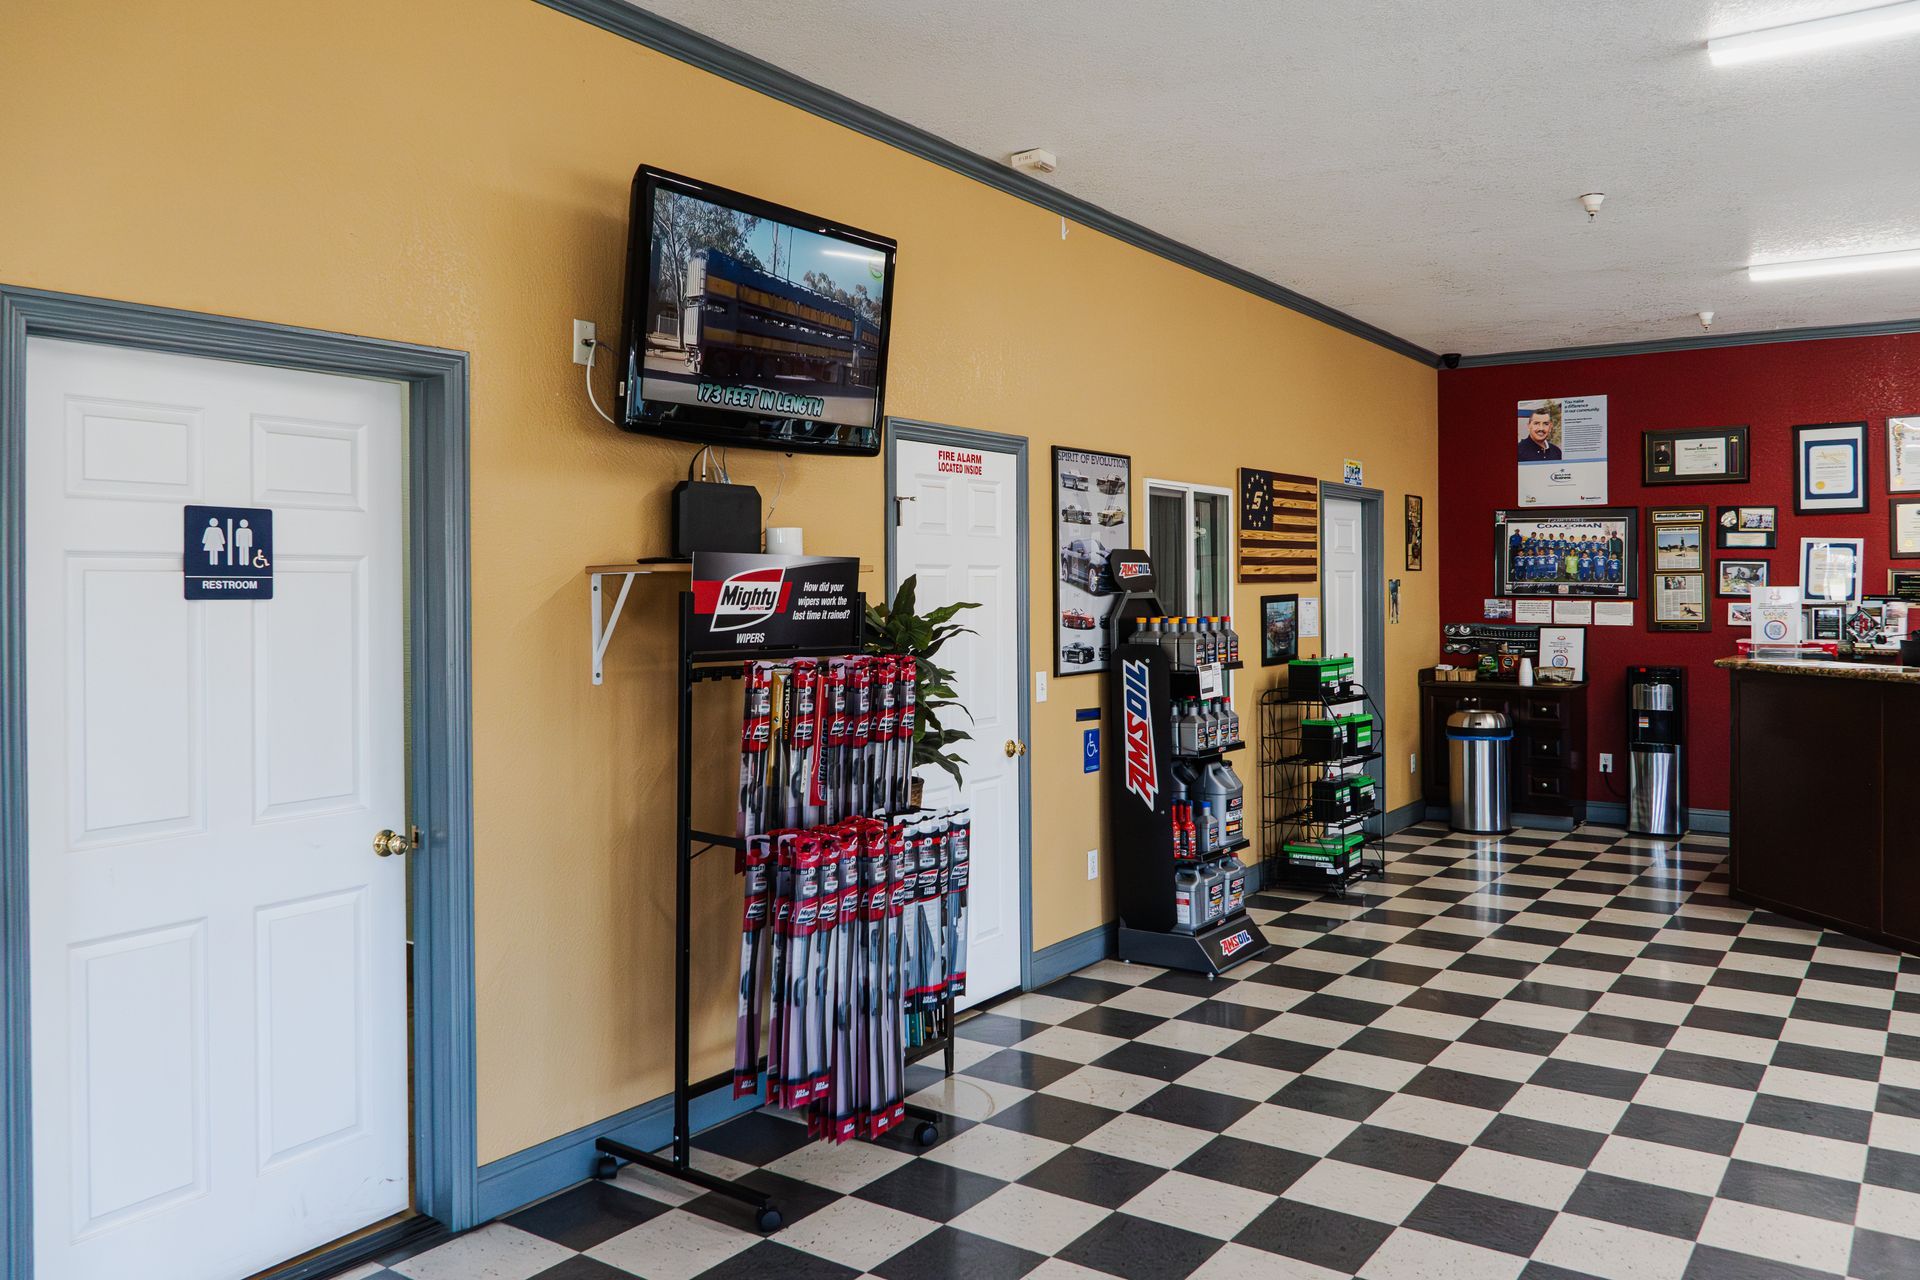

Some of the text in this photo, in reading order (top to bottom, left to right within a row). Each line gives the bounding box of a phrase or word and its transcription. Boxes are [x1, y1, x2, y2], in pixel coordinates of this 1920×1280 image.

[697, 382, 825, 417] 173 FEET IN LENGTH
[938, 450, 982, 464] FIRE ALARM
[1057, 450, 1128, 468] SPIRIT OF EVOLUTION
[938, 462, 982, 475] LOCATED INSIDE
[1251, 491, 1263, 510] 5
[1120, 562, 1151, 578] AMSOIL
[202, 580, 258, 590] RESTROOM
[803, 581, 844, 594] How did your
[720, 585, 777, 611] Mighty
[798, 596, 848, 608] wipers work the
[792, 610, 851, 620] last time it rained?
[736, 633, 765, 644] WIPERS
[784, 687, 792, 719] TRICO
[1124, 660, 1158, 811] AMSOIL
[1220, 930, 1252, 956] AMSOIL
